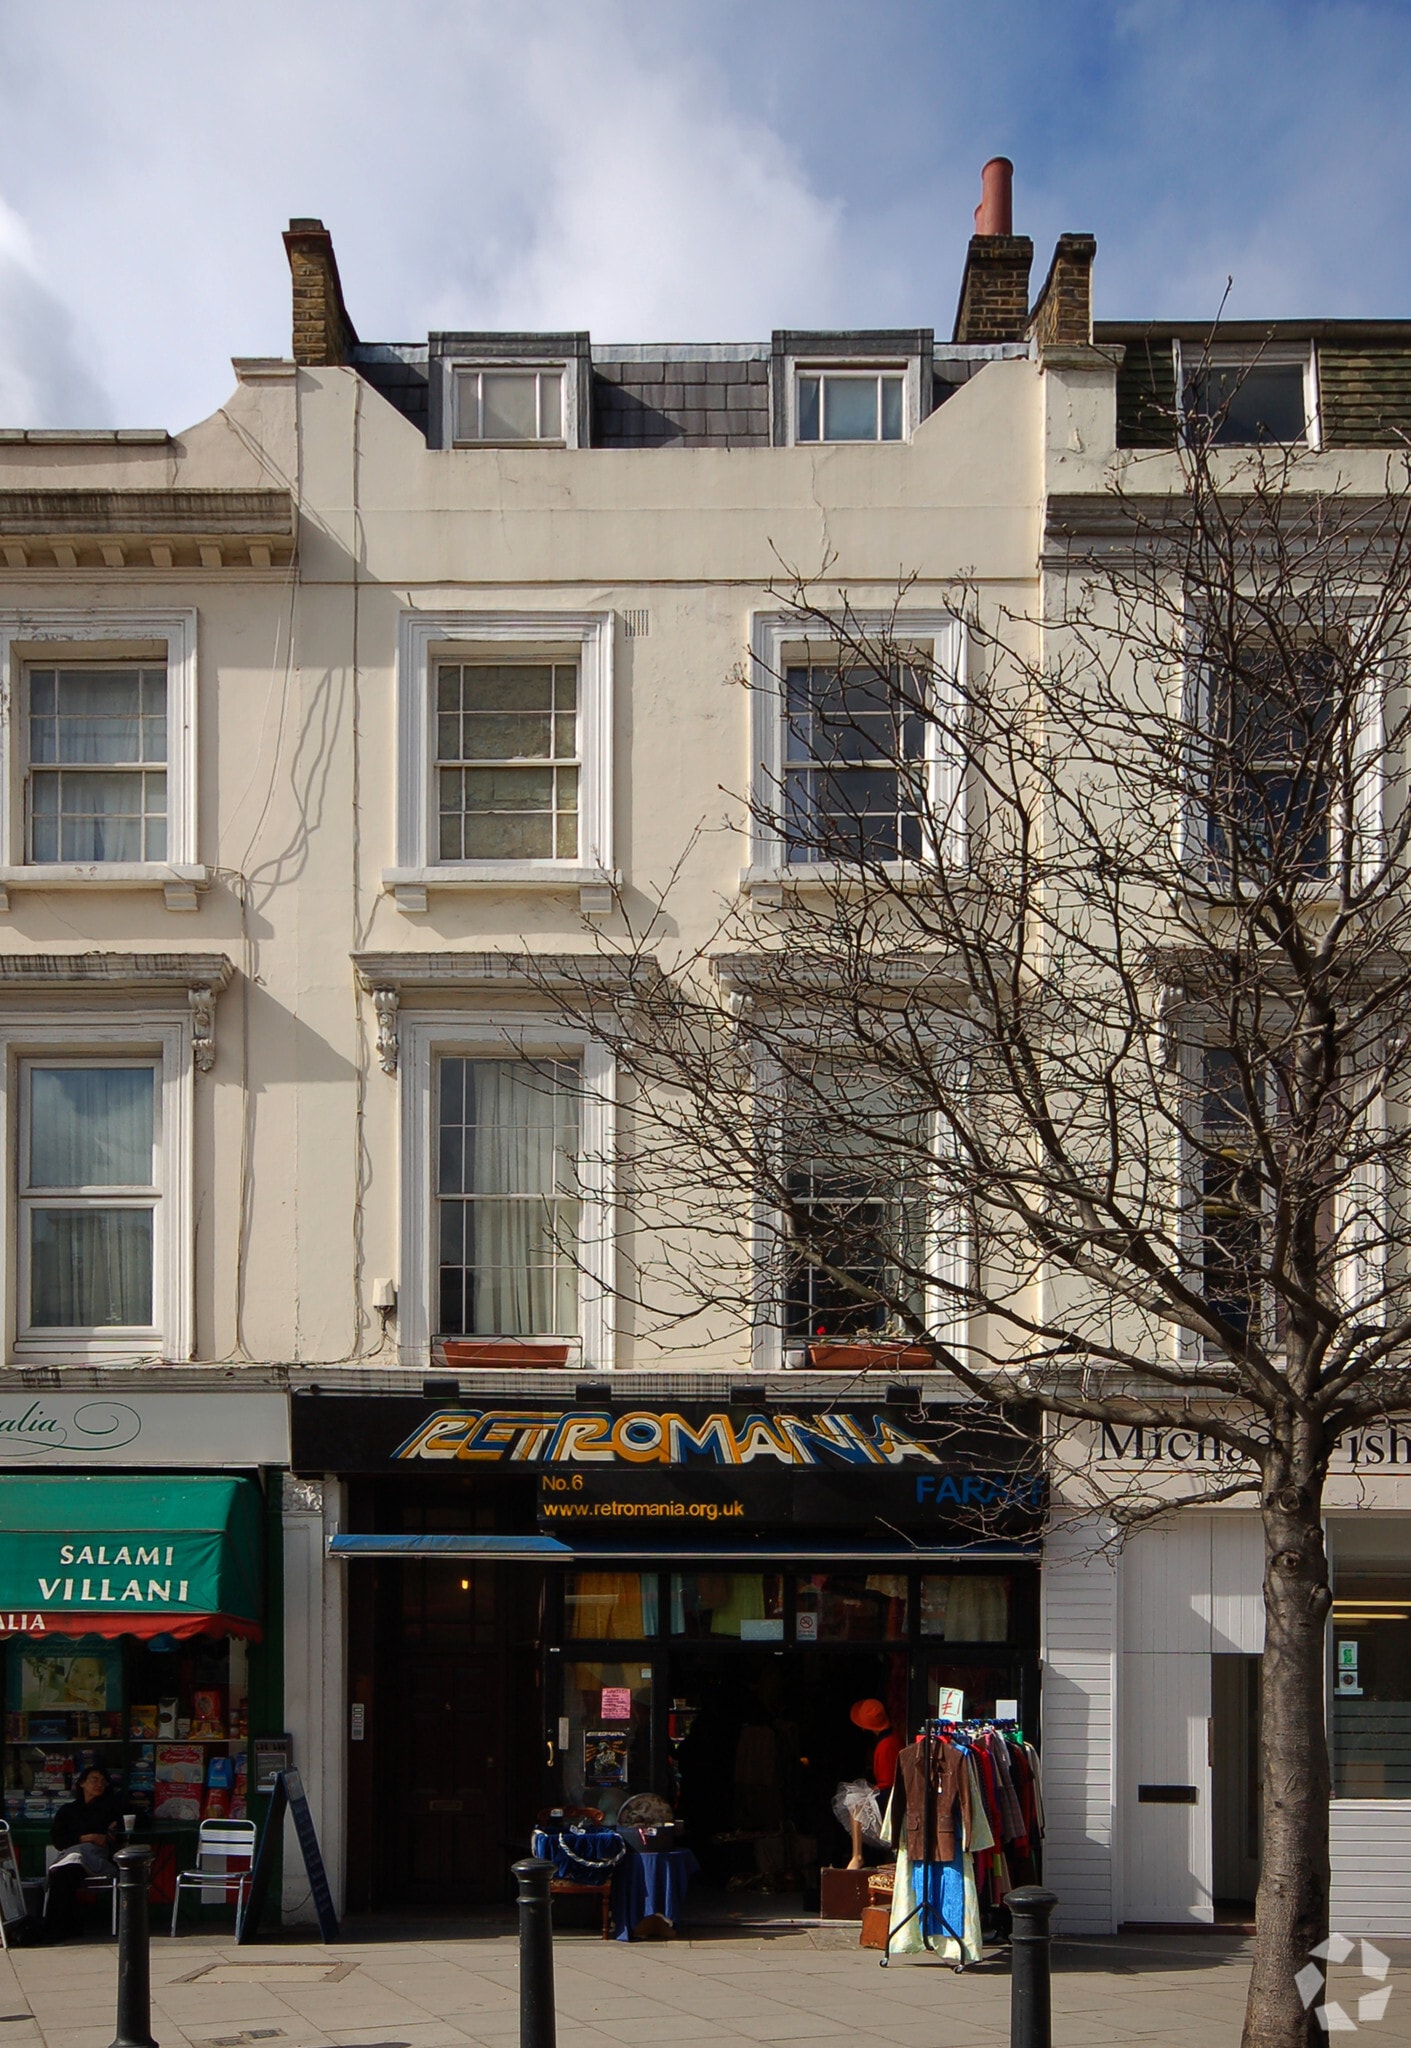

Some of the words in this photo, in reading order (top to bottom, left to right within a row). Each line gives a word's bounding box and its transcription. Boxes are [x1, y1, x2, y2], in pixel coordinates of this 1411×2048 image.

[390, 1409, 943, 1465] RETROMANIA
[1331, 1422, 1411, 1464] ish
[542, 1474, 584, 1492] No.6
[543, 1501, 745, 1521] www.retromania.org.uk
[60, 1545, 174, 1566] SALAMI
[38, 1578, 189, 1602] VILLANI
[941, 1688, 962, 1717] £1
